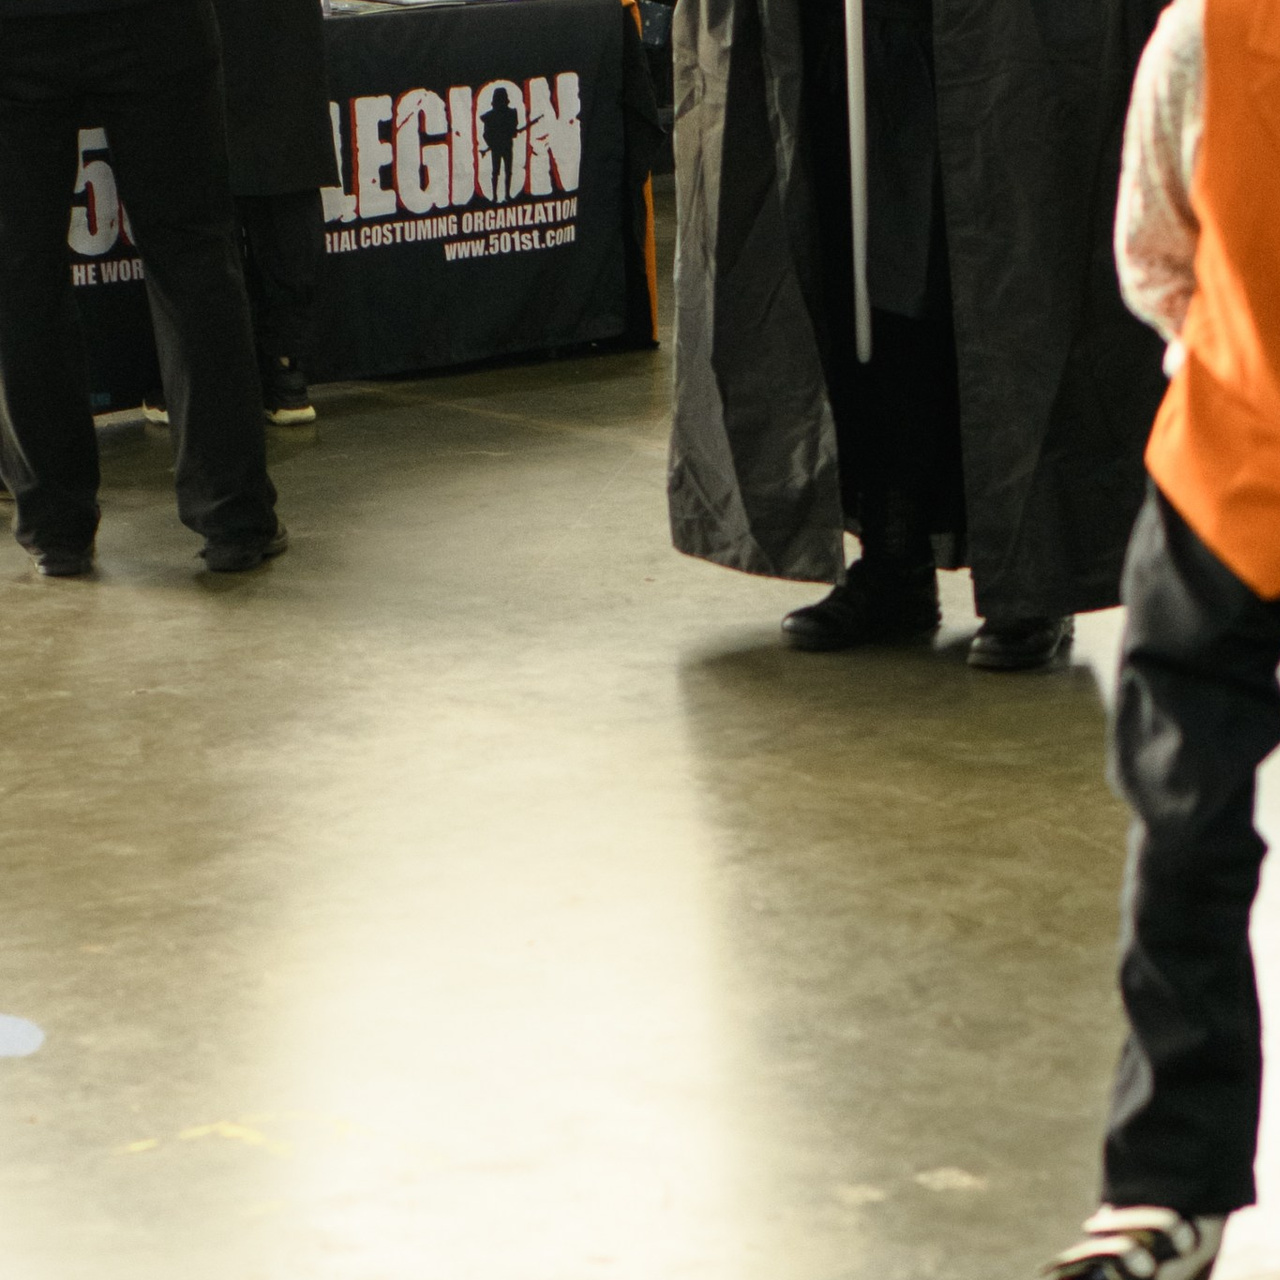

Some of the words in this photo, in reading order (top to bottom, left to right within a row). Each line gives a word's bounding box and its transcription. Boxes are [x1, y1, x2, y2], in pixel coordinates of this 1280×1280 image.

[360, 214, 458, 249] COSTUMING
[461, 196, 578, 234] ORGANIZATION
[444, 224, 576, 262] www.501st.com
